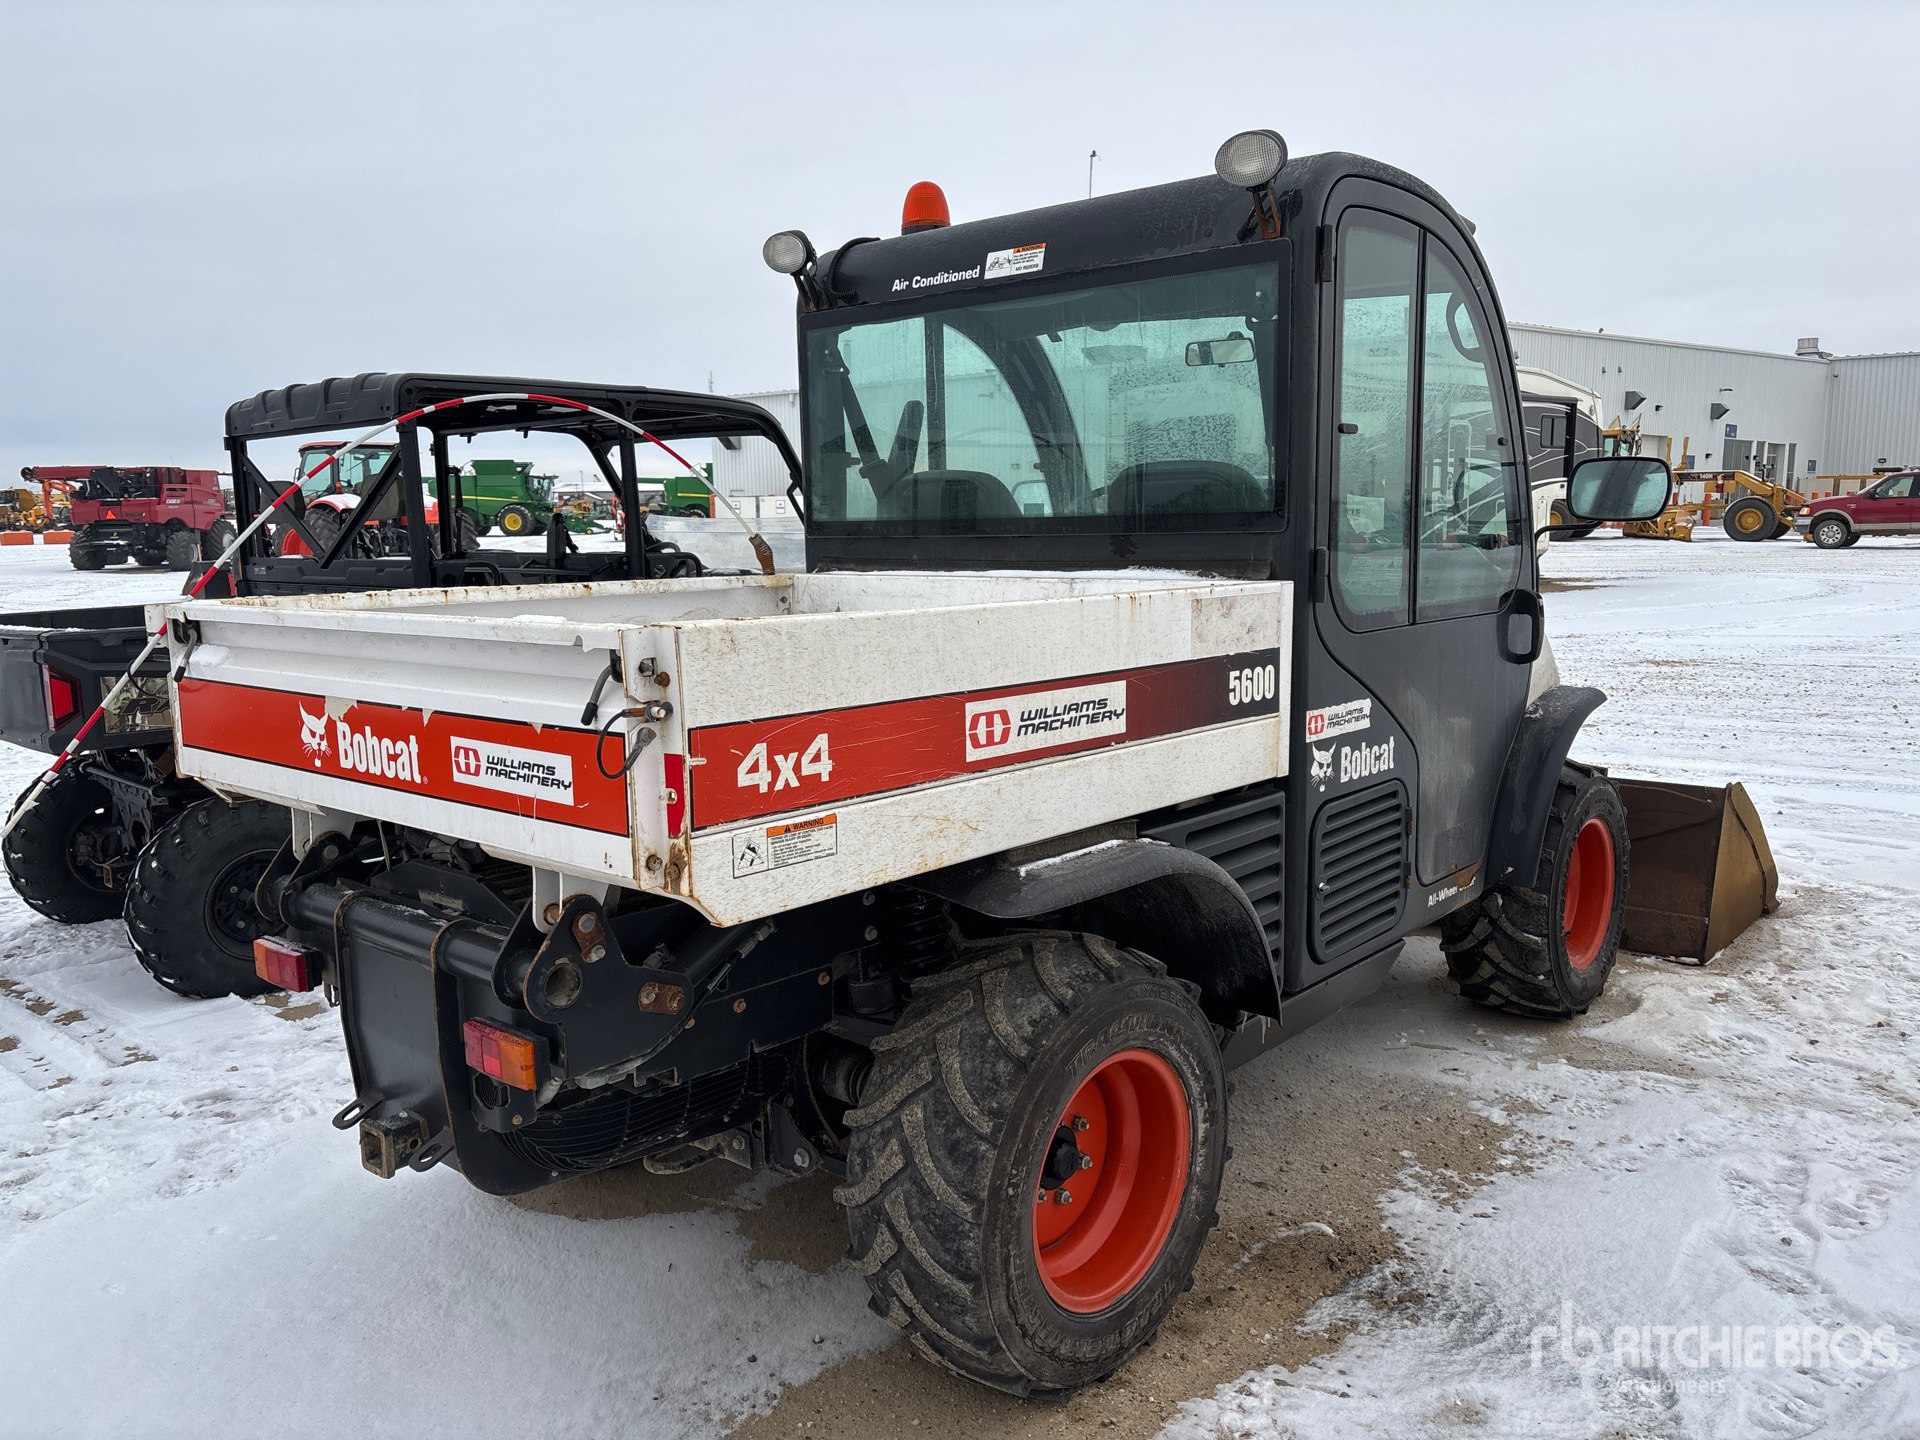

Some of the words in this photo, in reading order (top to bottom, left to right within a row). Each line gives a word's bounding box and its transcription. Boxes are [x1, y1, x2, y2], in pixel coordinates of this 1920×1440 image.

[892, 279, 909, 292] Air
[912, 265, 981, 289] Conditioned
[1228, 665, 1275, 706] 5600
[1017, 708, 1125, 737] MACHINERY
[1020, 698, 1108, 723] WILLIAMS
[1327, 713, 1371, 729] MACHINERY
[1328, 707, 1364, 721] WILLIAMS
[336, 721, 422, 784] Bobcat
[737, 733, 833, 794] 4x4
[1340, 736, 1395, 783] Bobcat
[485, 766, 572, 791] MACHINERY
[486, 755, 556, 777] WILLIAMS
[792, 818, 824, 831] WARNING
